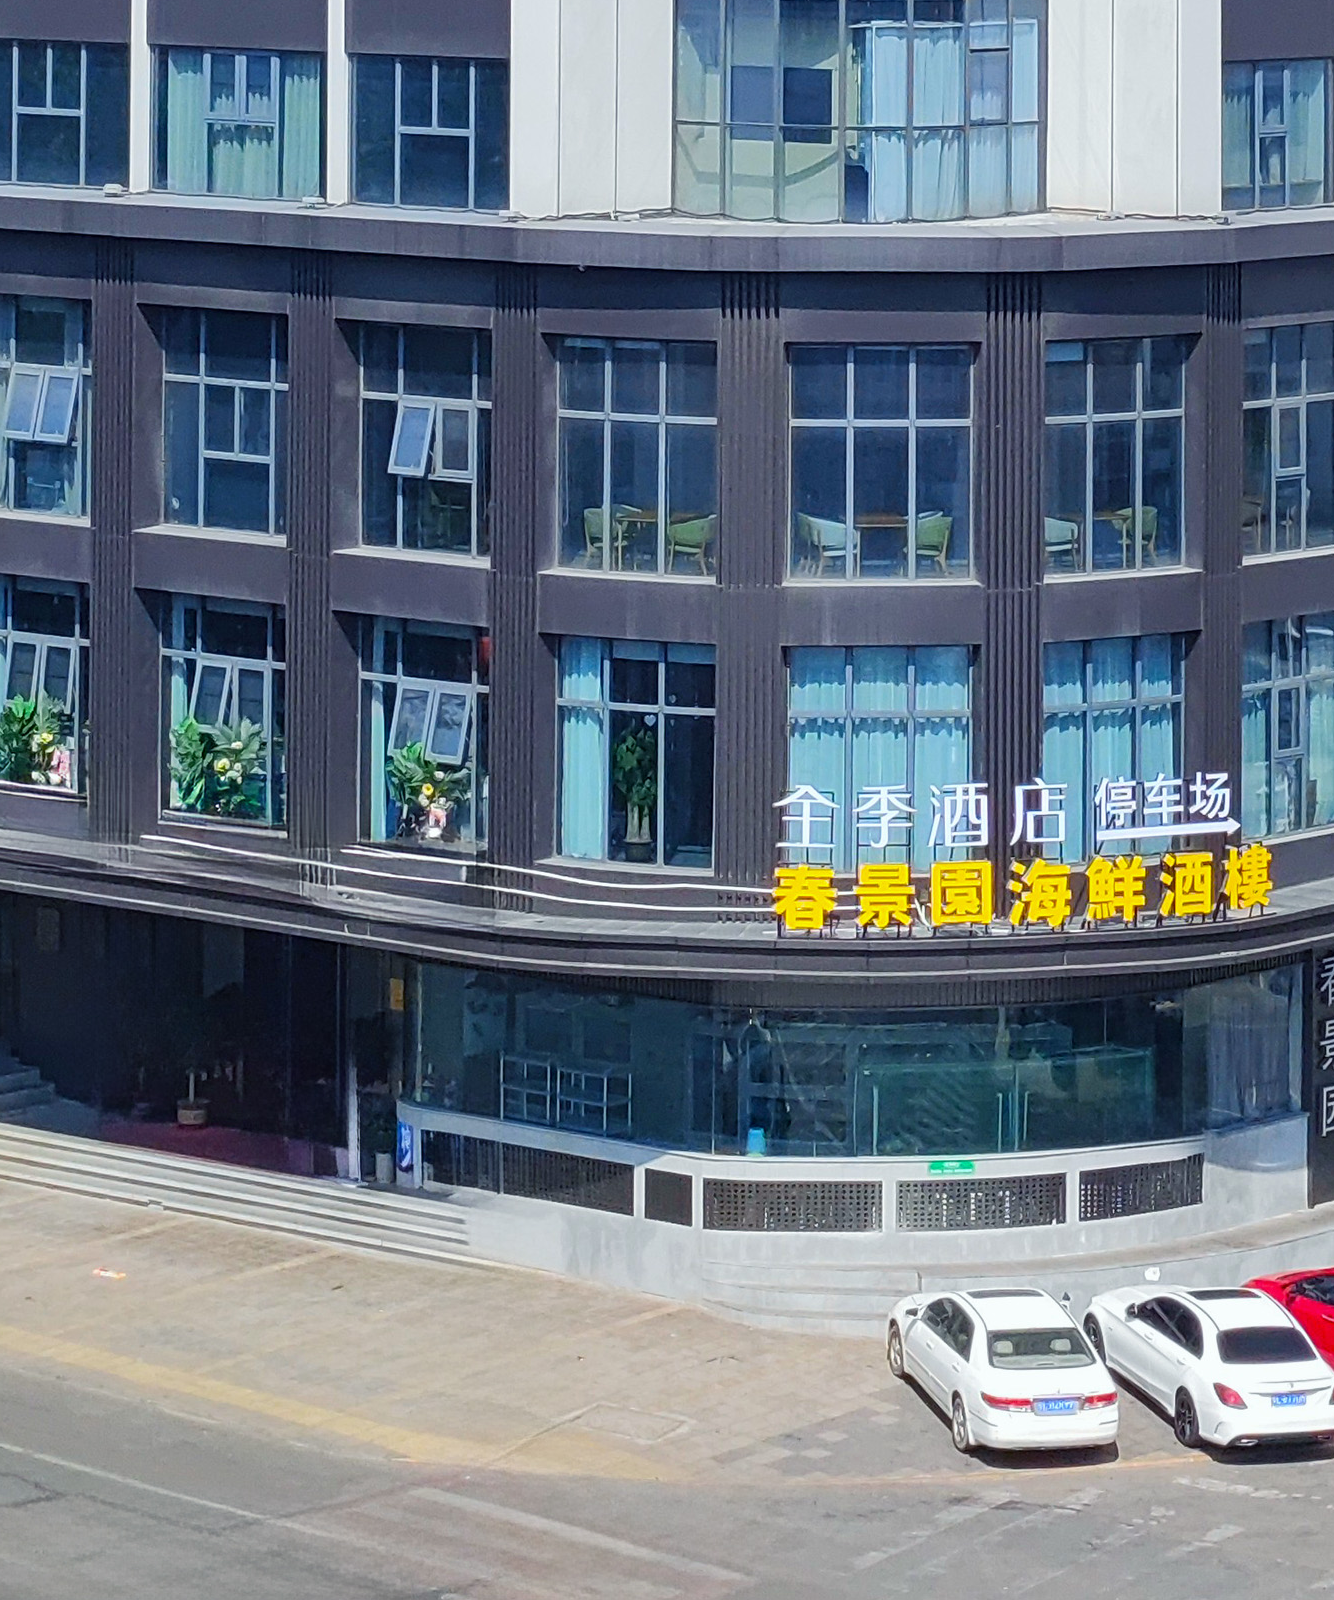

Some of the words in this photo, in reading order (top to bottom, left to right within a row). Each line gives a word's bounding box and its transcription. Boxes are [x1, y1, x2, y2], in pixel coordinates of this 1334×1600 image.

[772, 777, 1068, 849] 全季酒店
[1094, 771, 1231, 830] 停车场
[772, 841, 1274, 931] 春景園海鮮酒樓
